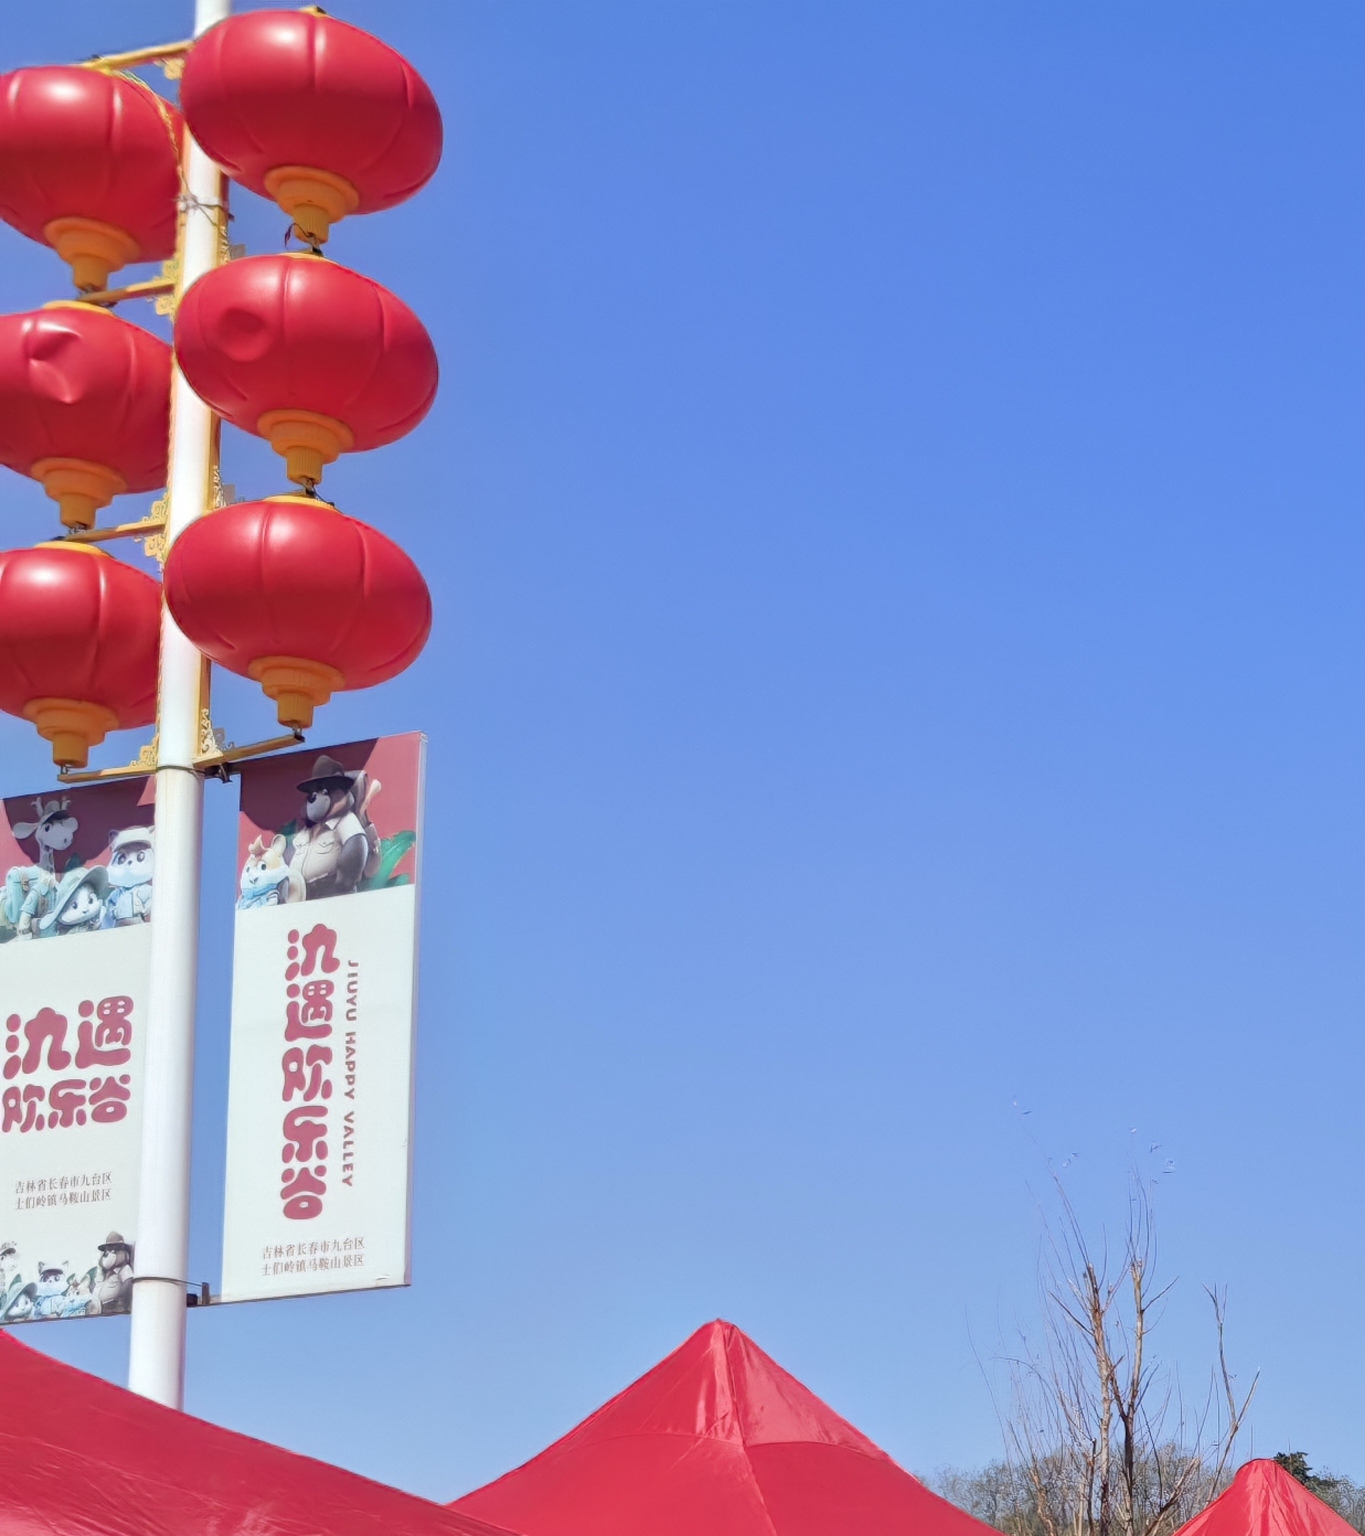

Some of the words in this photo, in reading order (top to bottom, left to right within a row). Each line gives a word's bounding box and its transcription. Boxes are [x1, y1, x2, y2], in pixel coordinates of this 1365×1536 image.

[345, 959, 359, 1021] JIUYU
[344, 1031, 357, 1100] HAPPY
[2, 1074, 131, 1133] 欢乐谷
[341, 1110, 355, 1187] VALLEY
[15, 1172, 112, 1194] 吉林省长春市九台区
[263, 1236, 365, 1260] 吉林省长春市九台区
